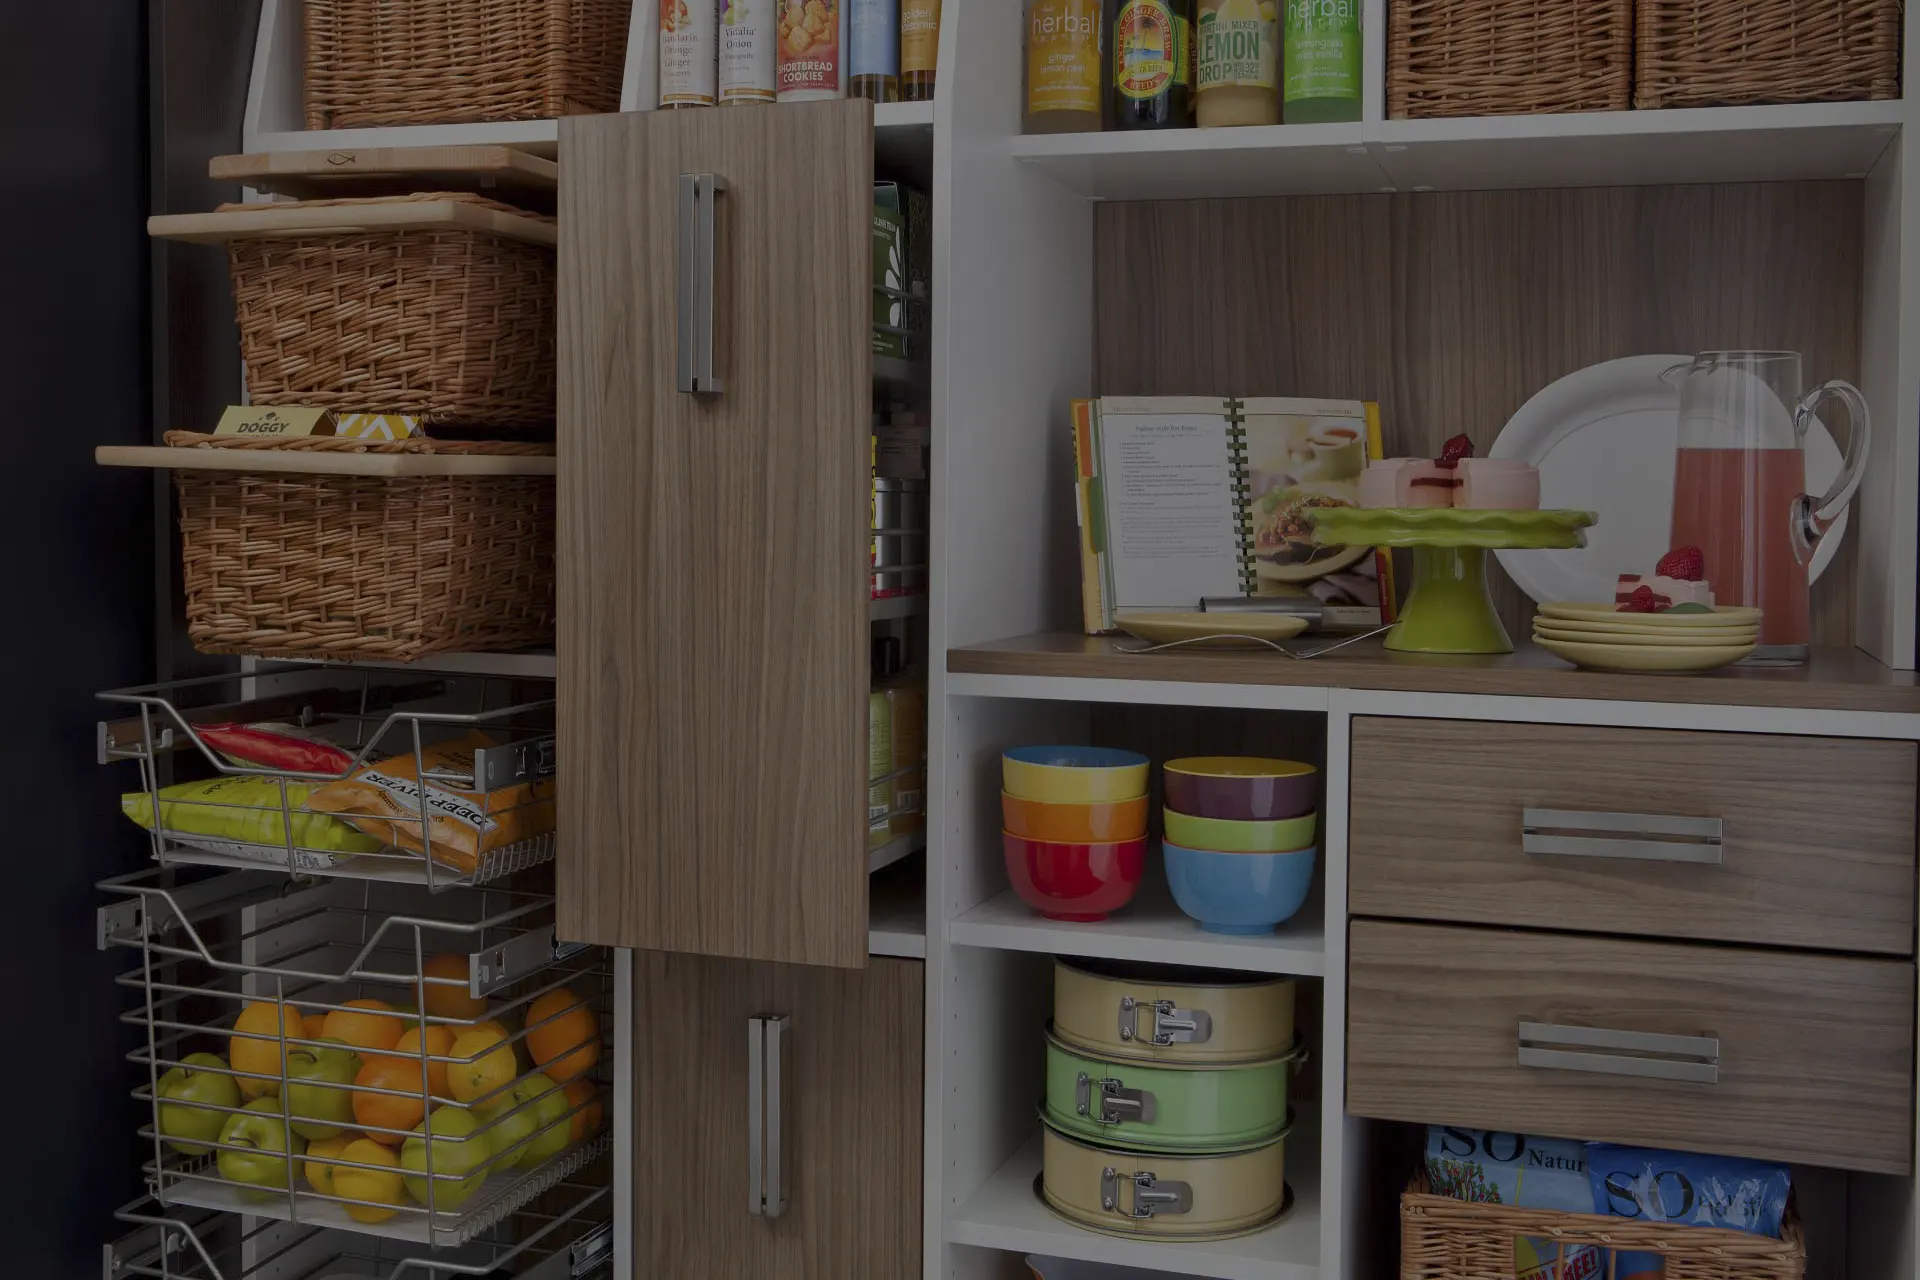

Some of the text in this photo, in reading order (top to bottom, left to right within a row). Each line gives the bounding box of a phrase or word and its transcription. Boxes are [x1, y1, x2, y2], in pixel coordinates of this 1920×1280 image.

[1032, 5, 1094, 36] herbal
[1288, 0, 1352, 21] herbal
[1232, 20, 1259, 29] MIXER
[1199, 31, 1260, 65] LEMON
[1316, 49, 1343, 59] vanilla
[778, 61, 833, 74] SHORTBREAD
[783, 71, 824, 83] COOKIES
[1199, 64, 1232, 84] DROP
[236, 422, 290, 433] DOGGY
[365, 773, 433, 801] RIVER
[430, 797, 488, 827] DEEP
[1439, 1125, 1526, 1162] SO
[1605, 1170, 1694, 1218] SO
